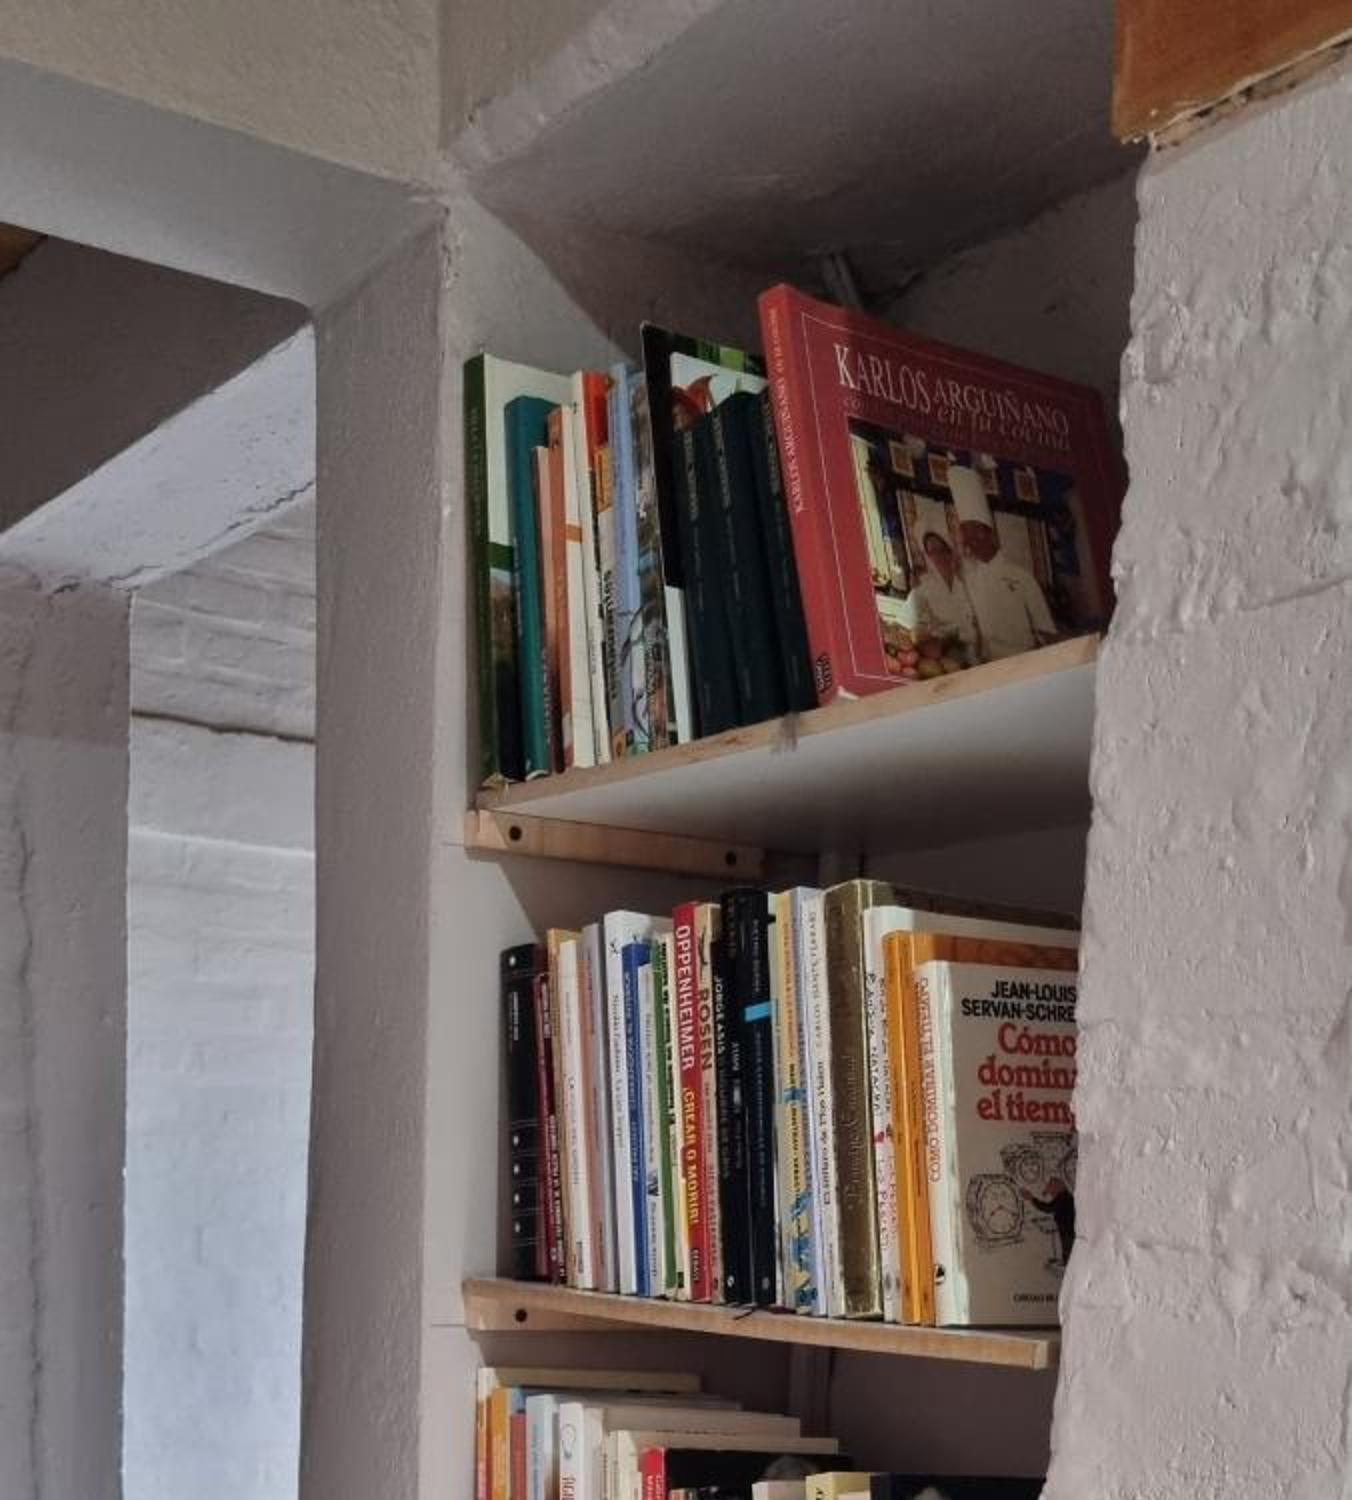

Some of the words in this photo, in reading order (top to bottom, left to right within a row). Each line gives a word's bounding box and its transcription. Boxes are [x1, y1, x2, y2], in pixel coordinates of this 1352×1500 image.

[833, 343, 931, 414] KARLOS
[931, 377, 1070, 434] ARGUIÑANO
[991, 980, 1077, 1003] JEAN-LOUIS
[699, 989, 713, 1071] ROSEN
[998, 1022, 1077, 1057] Cómo
[675, 925, 695, 1071] OPPENHEIMER
[687, 1165, 700, 1224] MORIR!
[924, 1060, 939, 1133] DOMINAR
[977, 1088, 1003, 1121] el
[927, 1138, 941, 1183] COMO
